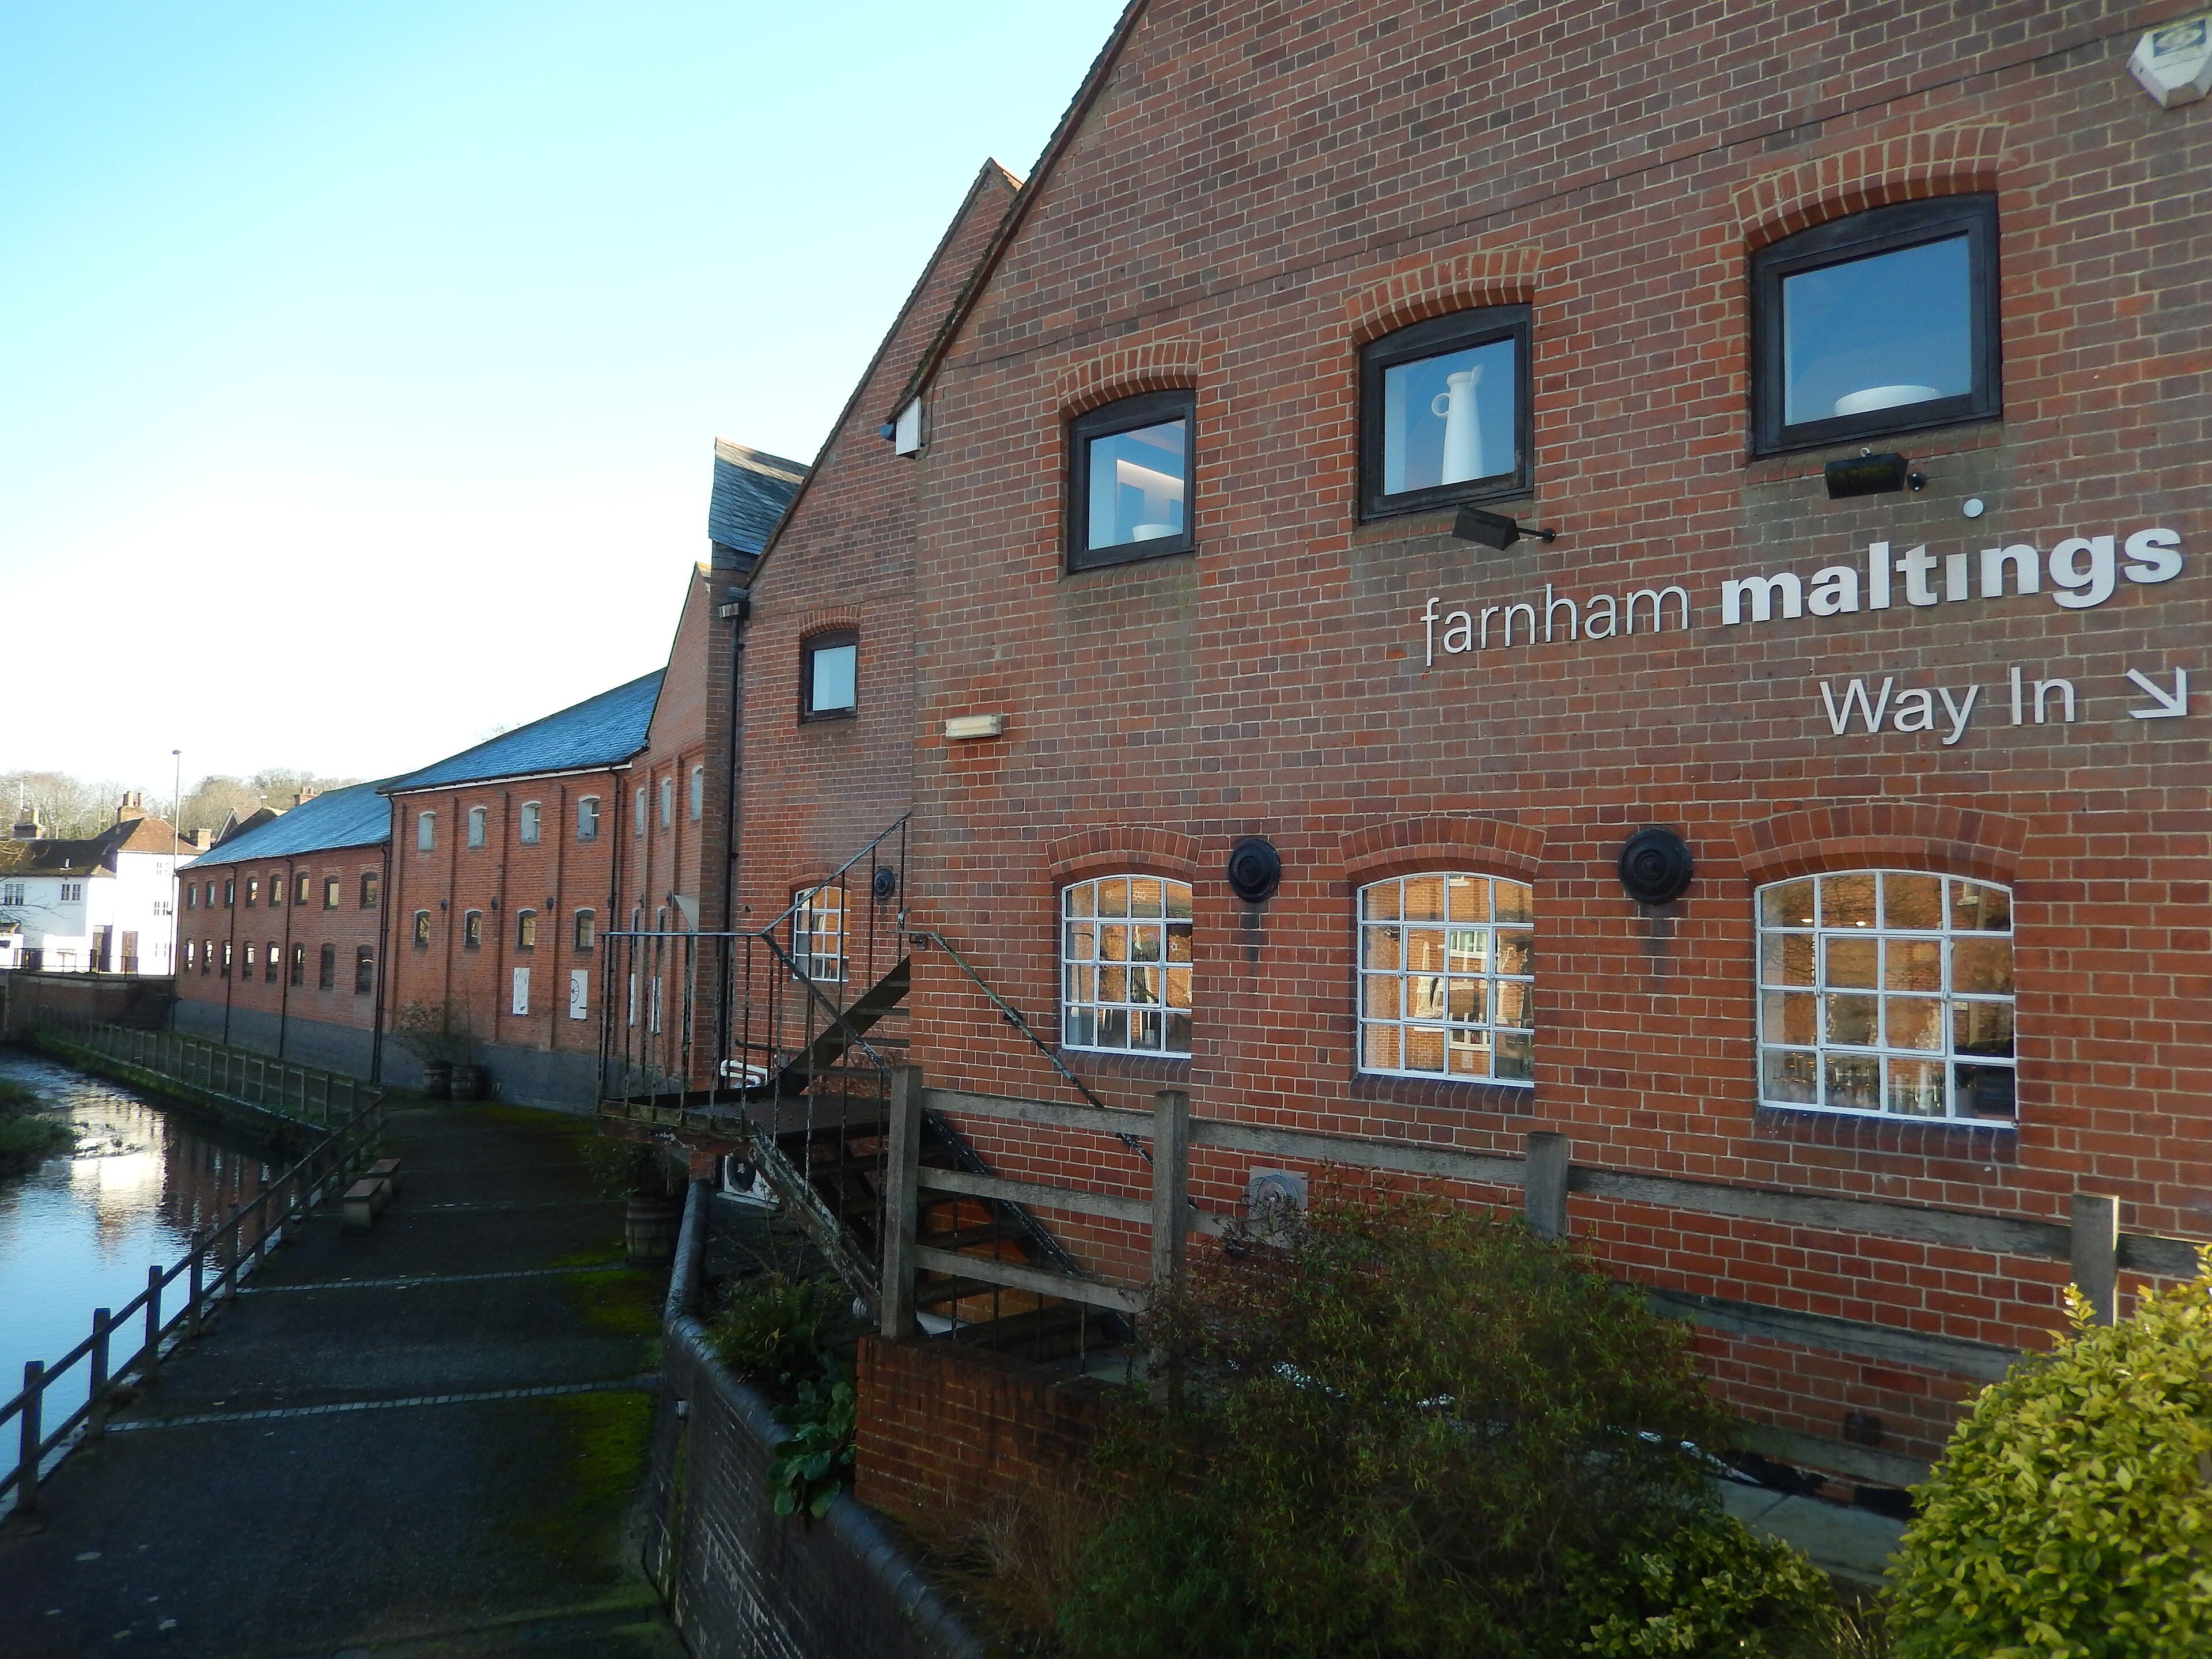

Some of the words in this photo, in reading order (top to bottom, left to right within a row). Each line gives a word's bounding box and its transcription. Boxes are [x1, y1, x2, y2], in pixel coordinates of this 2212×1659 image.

[1419, 583, 1689, 667] farnham
[1721, 499, 2183, 626] maltings
[1819, 676, 1979, 745] Way
[2010, 666, 2075, 726] In
